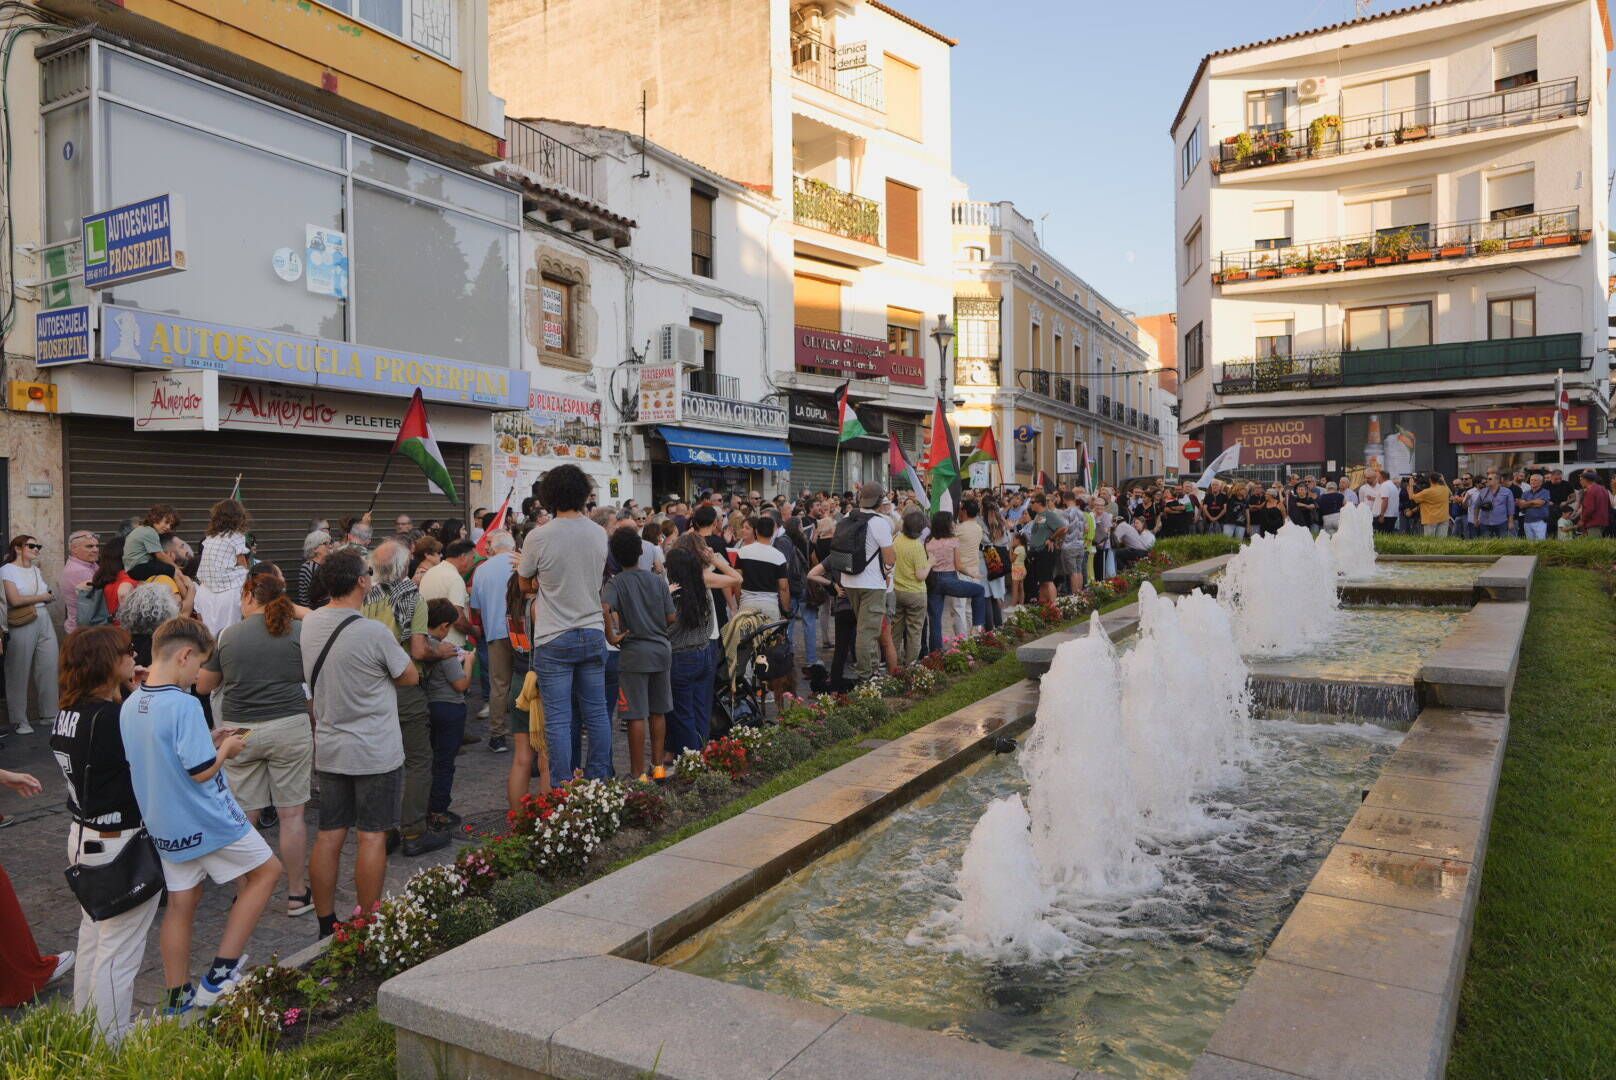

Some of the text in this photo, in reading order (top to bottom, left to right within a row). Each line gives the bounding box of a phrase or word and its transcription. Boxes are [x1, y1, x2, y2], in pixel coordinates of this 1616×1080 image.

[838, 55, 866, 68] dental
[108, 201, 169, 242] AUTOESCUELA
[87, 227, 105, 260] L
[109, 236, 170, 275] PROSERPINA
[38, 312, 88, 338] AUTOESCUELA
[38, 335, 88, 360] PROSERPINA
[803, 335, 842, 352] OLIVERA
[150, 322, 508, 396] AUTOESCUELA PROSERPINA
[891, 362, 922, 377] OLIVERA
[150, 386, 202, 416] Almendro
[229, 385, 337, 429] Almendro
[537, 394, 560, 412] PLAZA
[795, 404, 804, 416] LA
[346, 414, 401, 429] PELETER
[682, 396, 732, 421] TORERIA
[733, 404, 787, 428] GUERRERO
[1241, 420, 1304, 435] ESTANCO
[1487, 415, 1578, 429] TABACS
[1235, 436, 1250, 448] EL
[718, 451, 778, 466] LAVANDERIA
[1255, 447, 1292, 460] ROJO
[57, 709, 80, 738] BAR
[152, 831, 203, 851] TRANS
